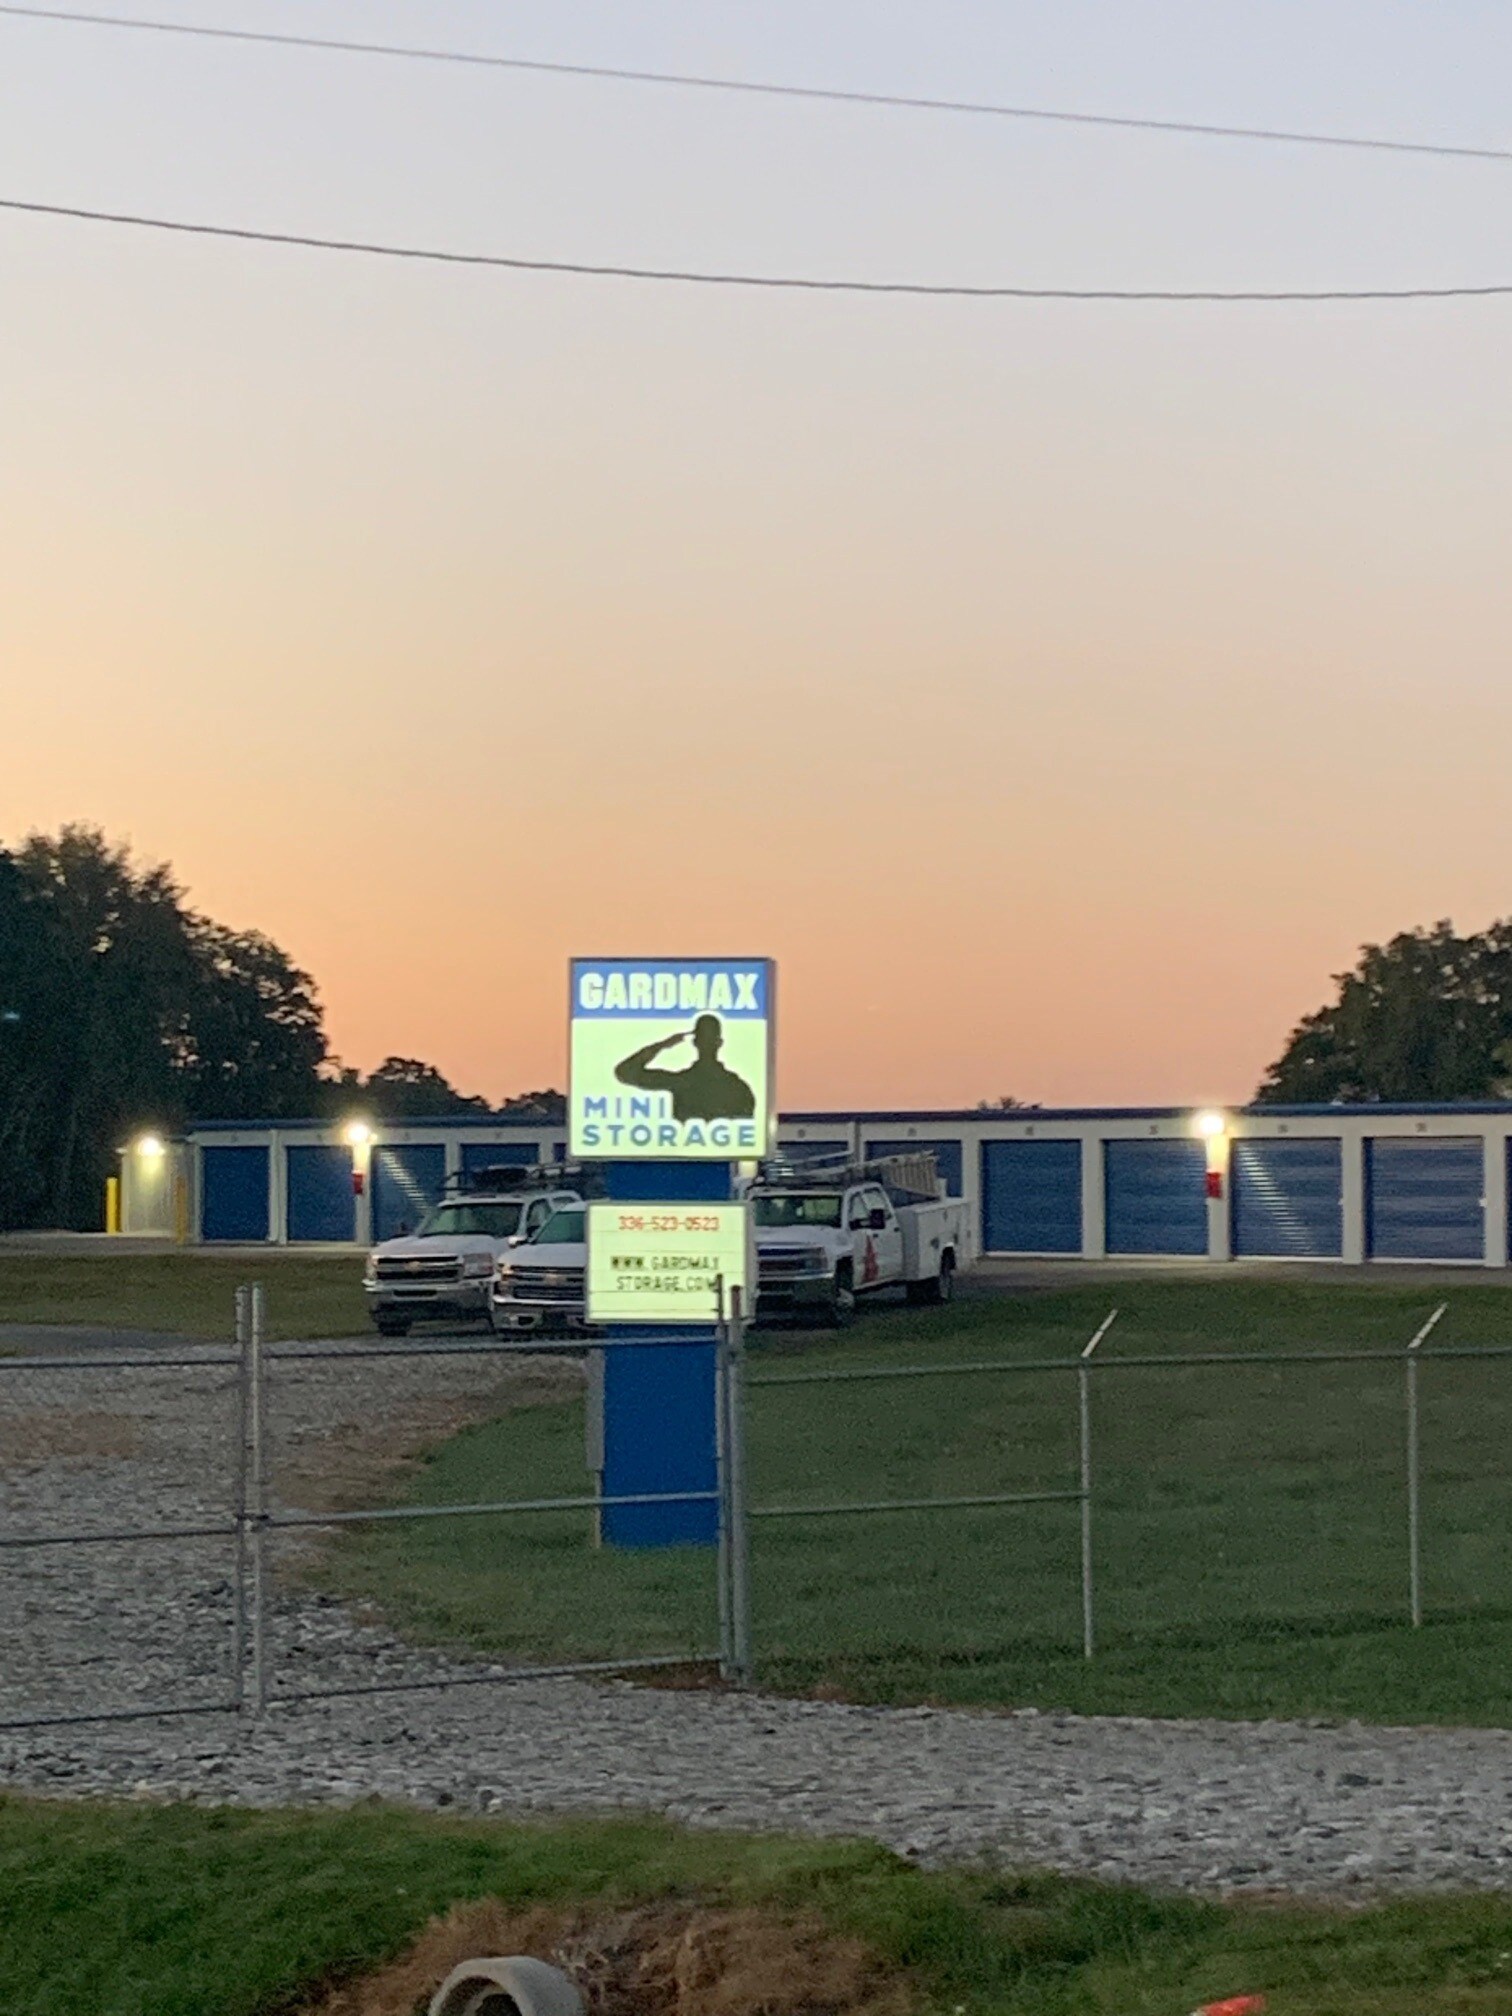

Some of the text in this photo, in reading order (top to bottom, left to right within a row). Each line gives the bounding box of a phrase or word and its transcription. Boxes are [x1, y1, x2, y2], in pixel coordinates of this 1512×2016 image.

[579, 972, 759, 1010] GARDMAX
[583, 1096, 665, 1118] MINI
[581, 1124, 756, 1147] STORAGE
[618, 1215, 720, 1231] 336-523-0523
